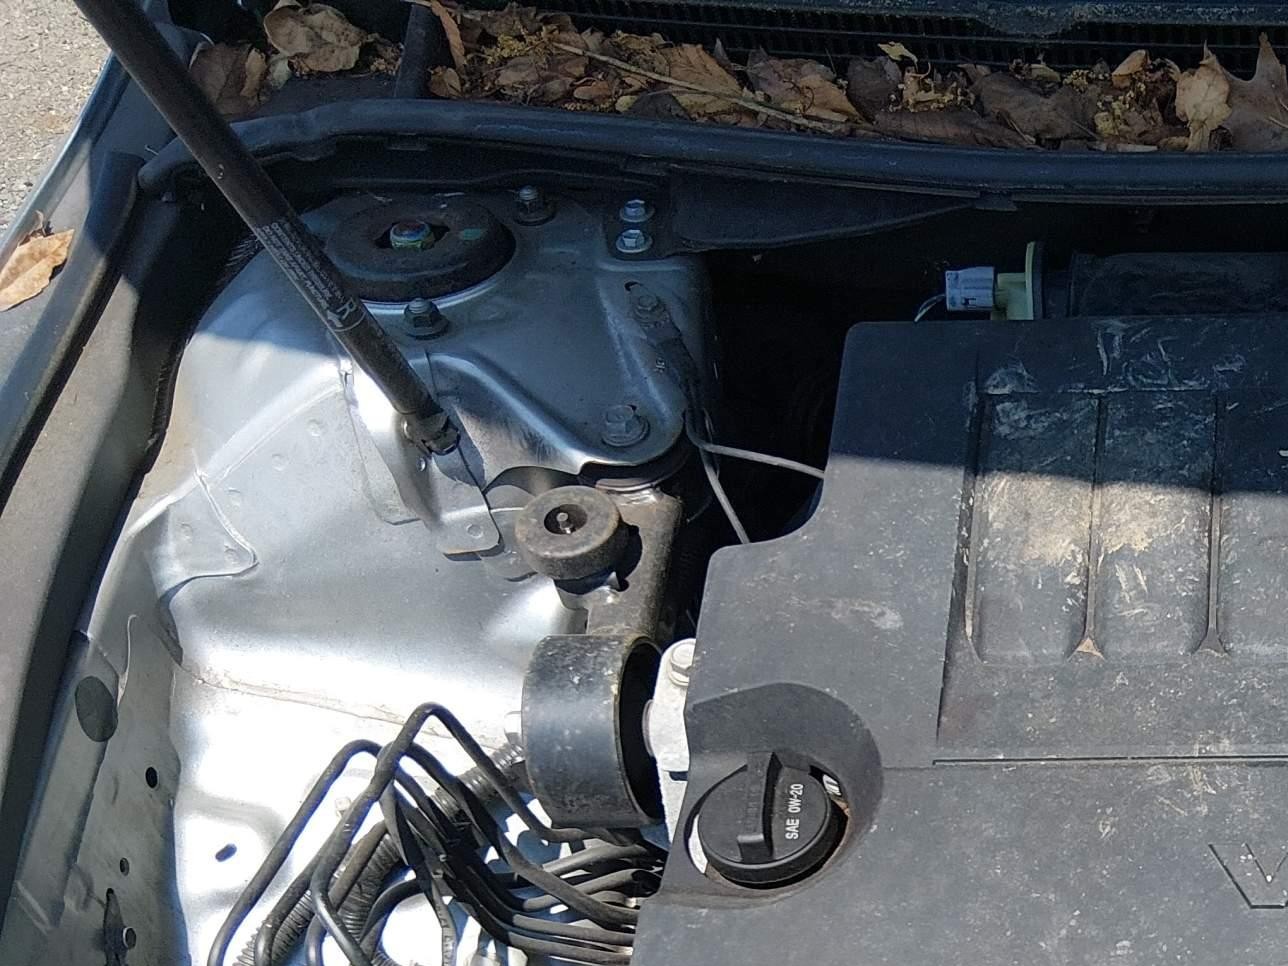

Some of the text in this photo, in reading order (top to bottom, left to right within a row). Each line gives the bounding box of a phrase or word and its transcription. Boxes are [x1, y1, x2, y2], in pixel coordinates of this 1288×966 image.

[336, 296, 357, 320] R
[784, 783, 804, 839] SAE 0W-20
